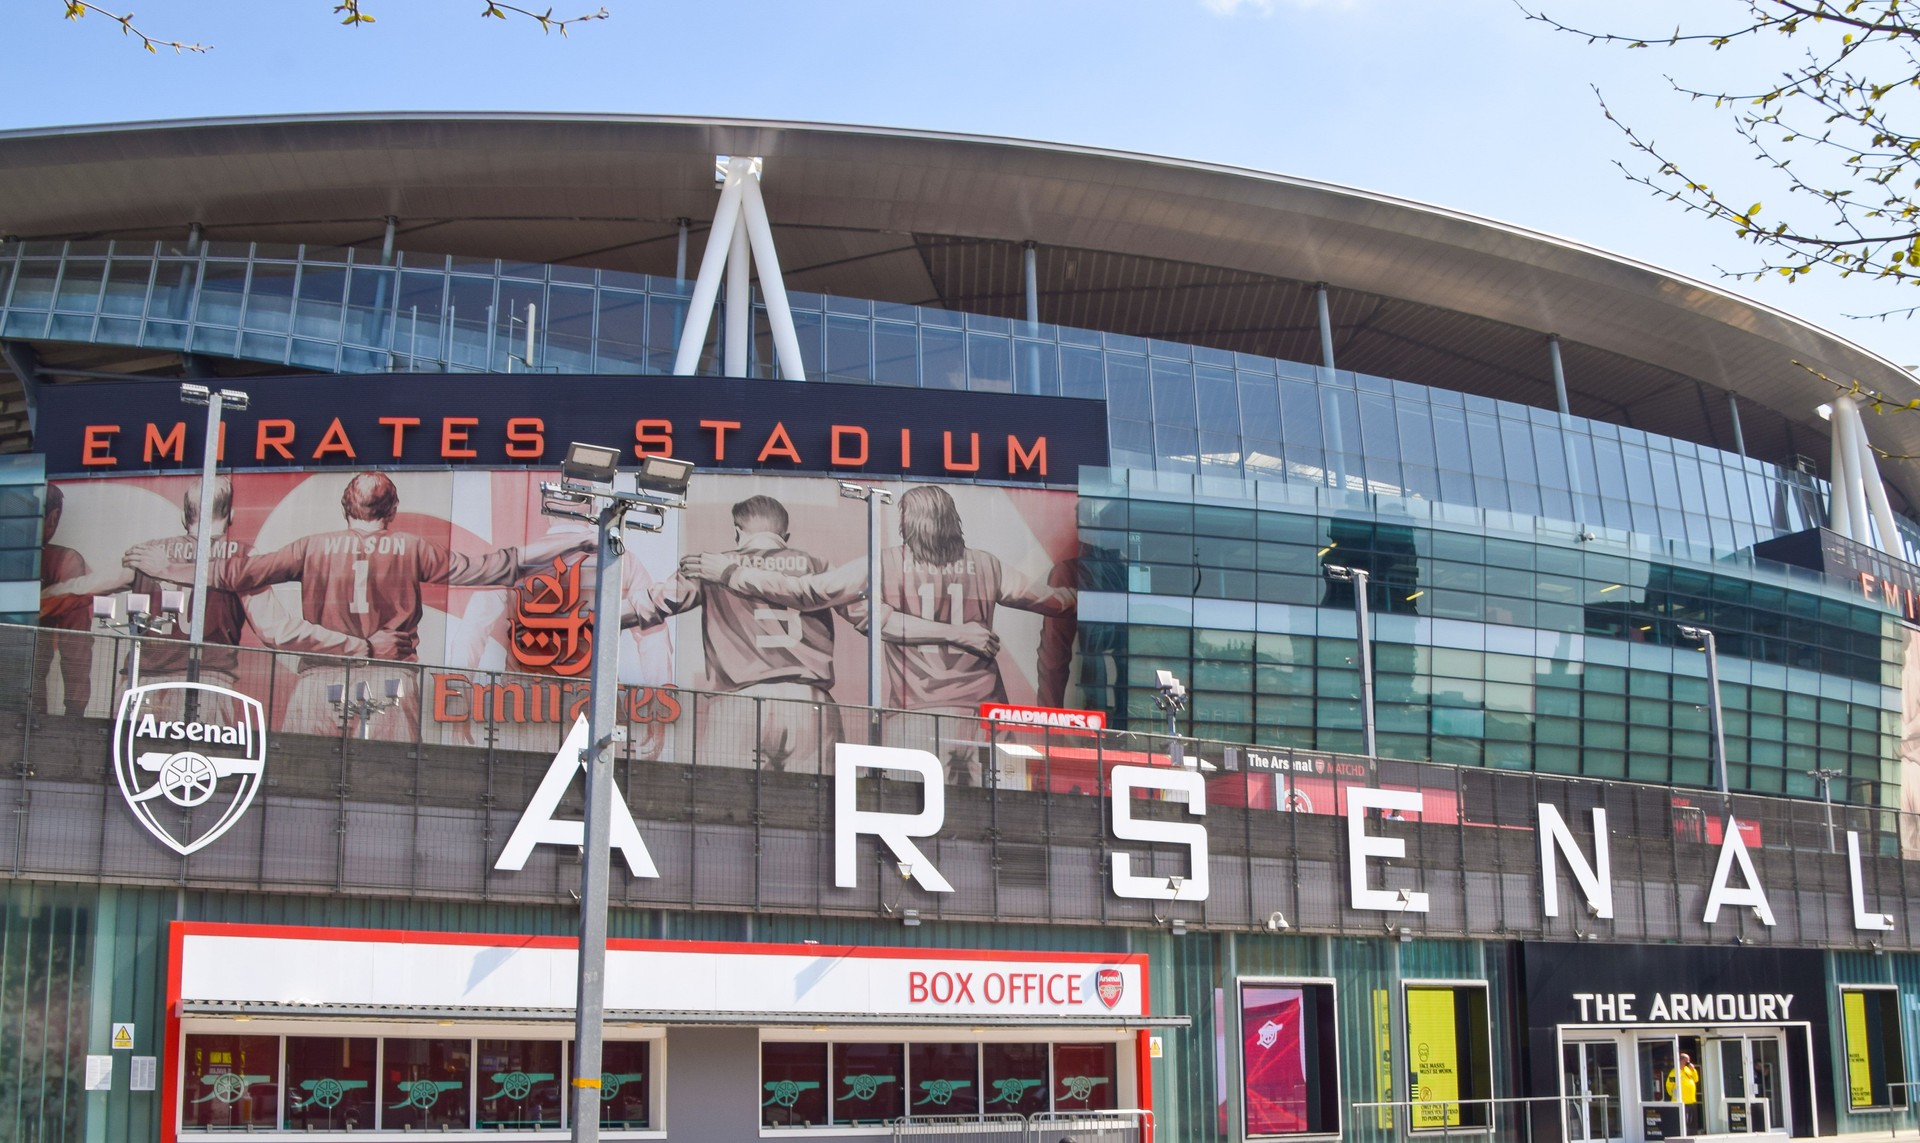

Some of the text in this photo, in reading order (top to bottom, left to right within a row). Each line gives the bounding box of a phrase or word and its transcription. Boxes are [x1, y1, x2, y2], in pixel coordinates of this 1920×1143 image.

[83, 416, 1047, 476] EMIRATES STADIUM
[324, 535, 405, 556] WILSON
[349, 559, 370, 614] 1
[1859, 571, 1920, 626] EMI
[431, 672, 682, 724] Emiraes
[136, 713, 246, 746] Arsenal
[988, 707, 1086, 729] CHAPMAN'S
[1248, 753, 1269, 769] The
[1270, 756, 1314, 773] Arsnal
[494, 712, 1896, 931] ARSENAL
[909, 971, 1083, 1005] BOX OFFICE
[1099, 975, 1121, 983] Arsenal
[1573, 992, 1794, 1022] THE ARMOURY
